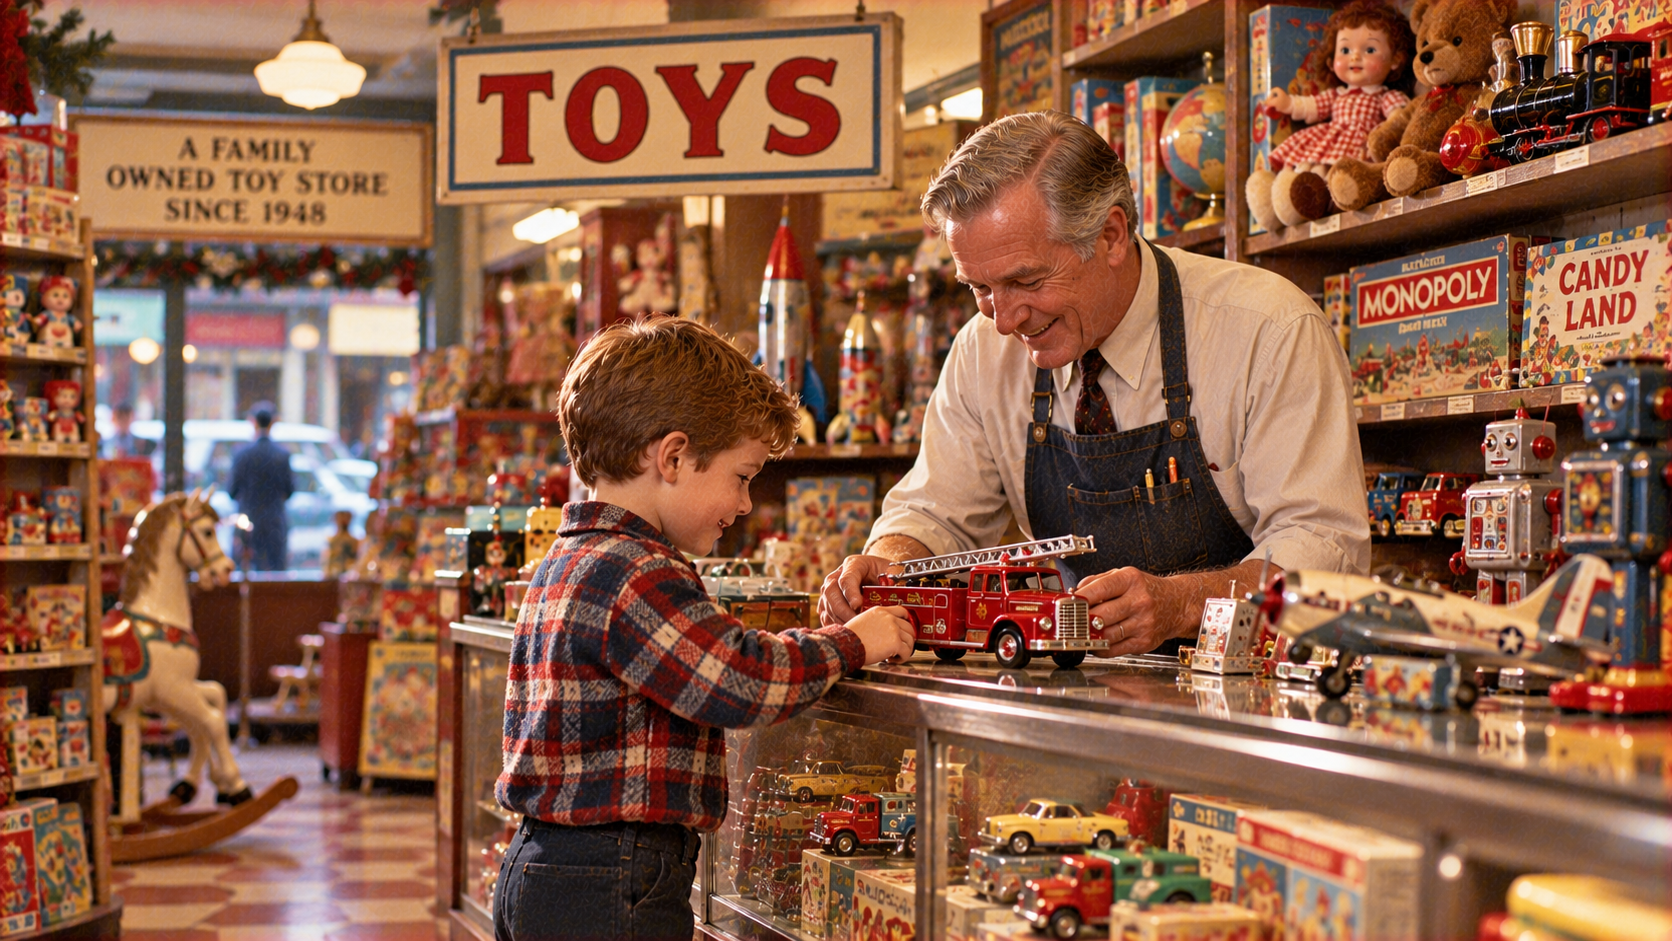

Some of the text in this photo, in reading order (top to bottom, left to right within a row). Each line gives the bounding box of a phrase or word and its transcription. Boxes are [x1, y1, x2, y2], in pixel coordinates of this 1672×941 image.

[478, 57, 841, 165] TOYS
[178, 136, 315, 163] A FAMILY
[106, 165, 389, 197] OWNED TOY STORE
[165, 198, 327, 226] SINCE 1948
[1363, 266, 1492, 320] MONOPOLY
[1559, 249, 1650, 296] CANDY
[1565, 291, 1637, 332] LAND
